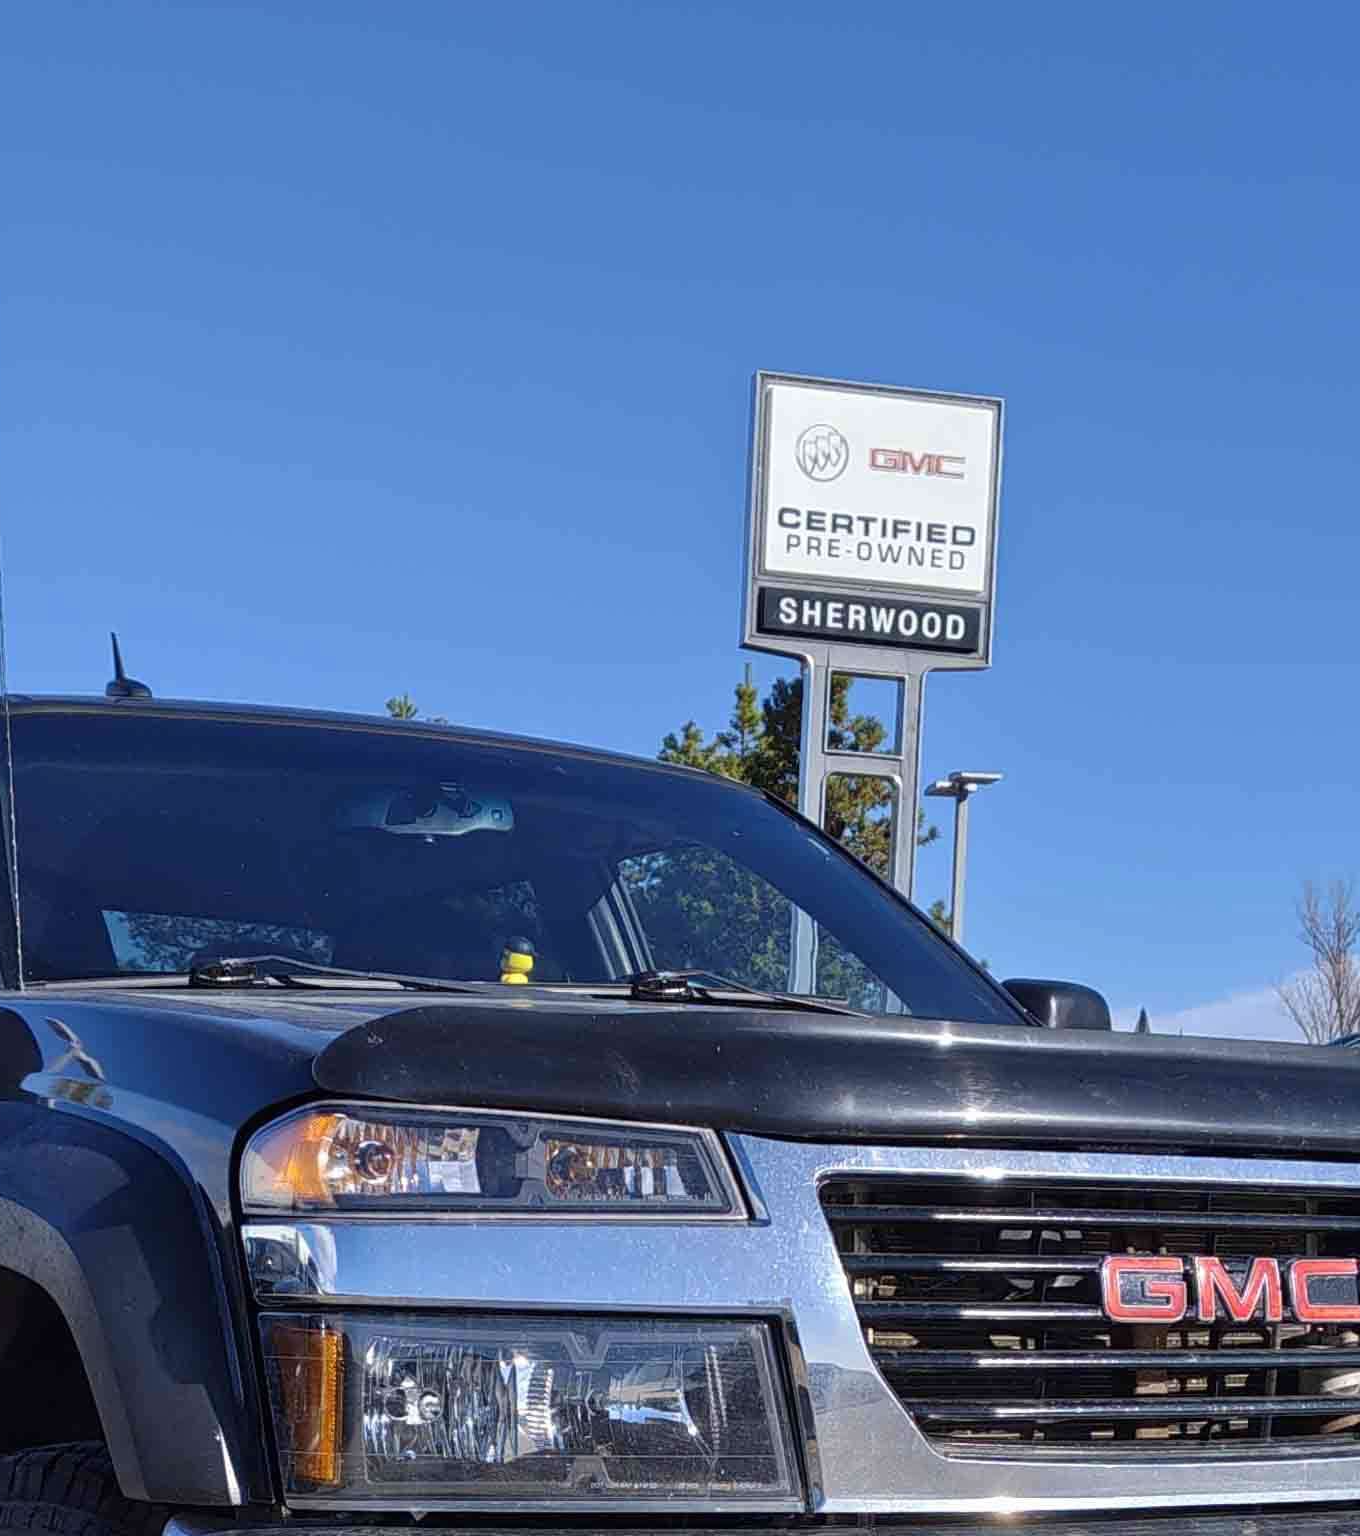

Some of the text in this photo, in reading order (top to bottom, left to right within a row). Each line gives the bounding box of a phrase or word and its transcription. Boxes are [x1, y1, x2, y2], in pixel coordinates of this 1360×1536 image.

[869, 447, 966, 479] GMC
[777, 507, 976, 547] CERTIFIED
[785, 534, 965, 570] PRE-OWNED
[778, 596, 966, 641] SHERWOOD
